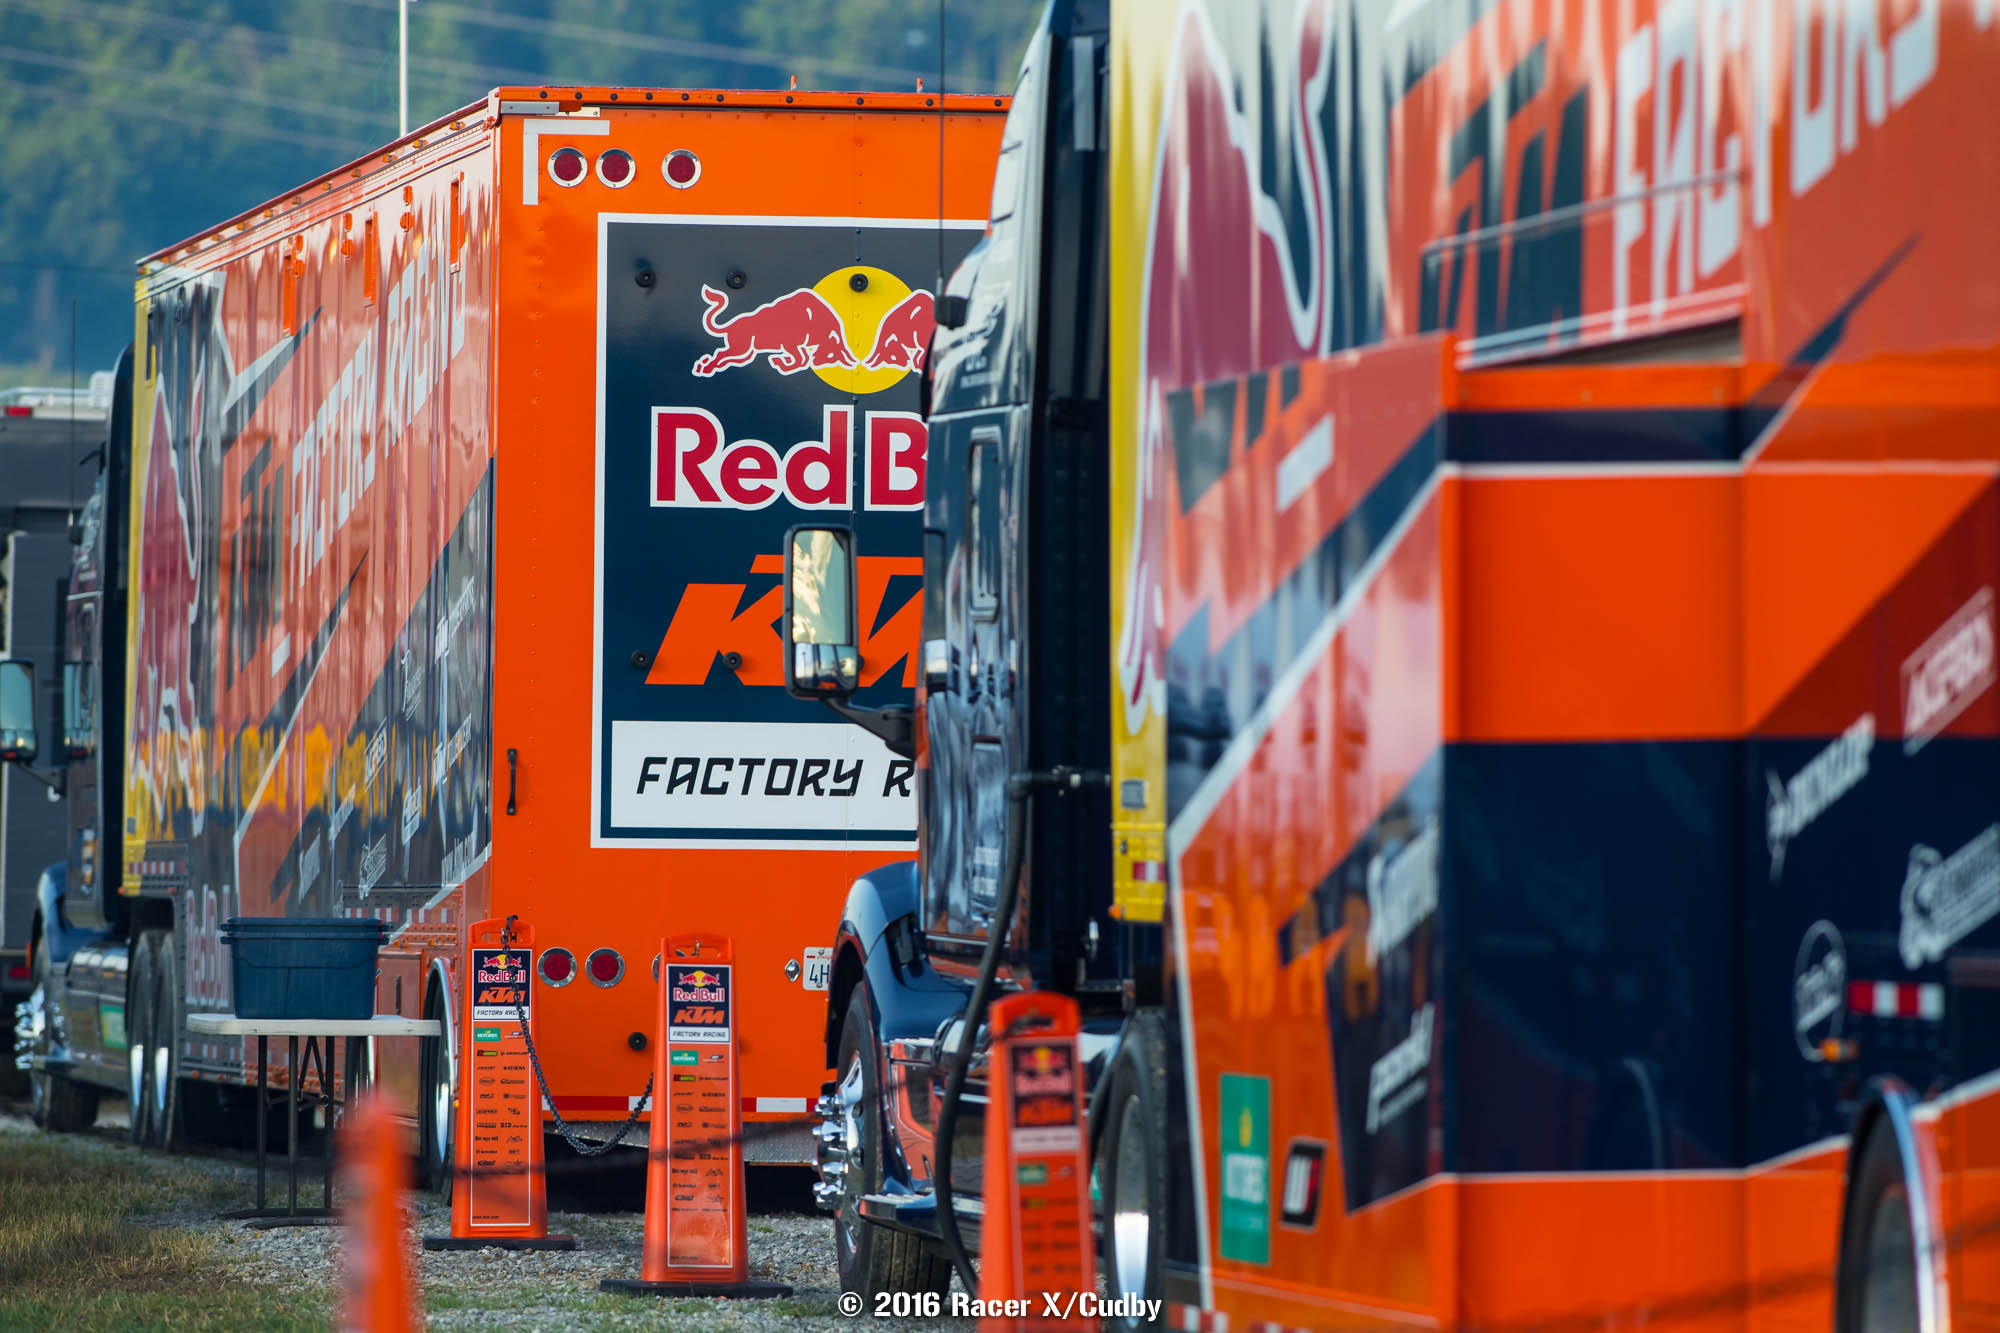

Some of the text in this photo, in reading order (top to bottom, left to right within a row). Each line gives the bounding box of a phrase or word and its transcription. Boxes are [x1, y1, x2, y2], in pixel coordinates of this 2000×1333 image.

[289, 222, 466, 604] FACTORY RACING
[650, 404, 853, 510] Red
[636, 756, 863, 796] FACTORY
[478, 970, 502, 983] Red
[478, 986, 526, 1003] KTM
[673, 988, 725, 1003] Red Bull
[673, 1006, 725, 1024] KTM
